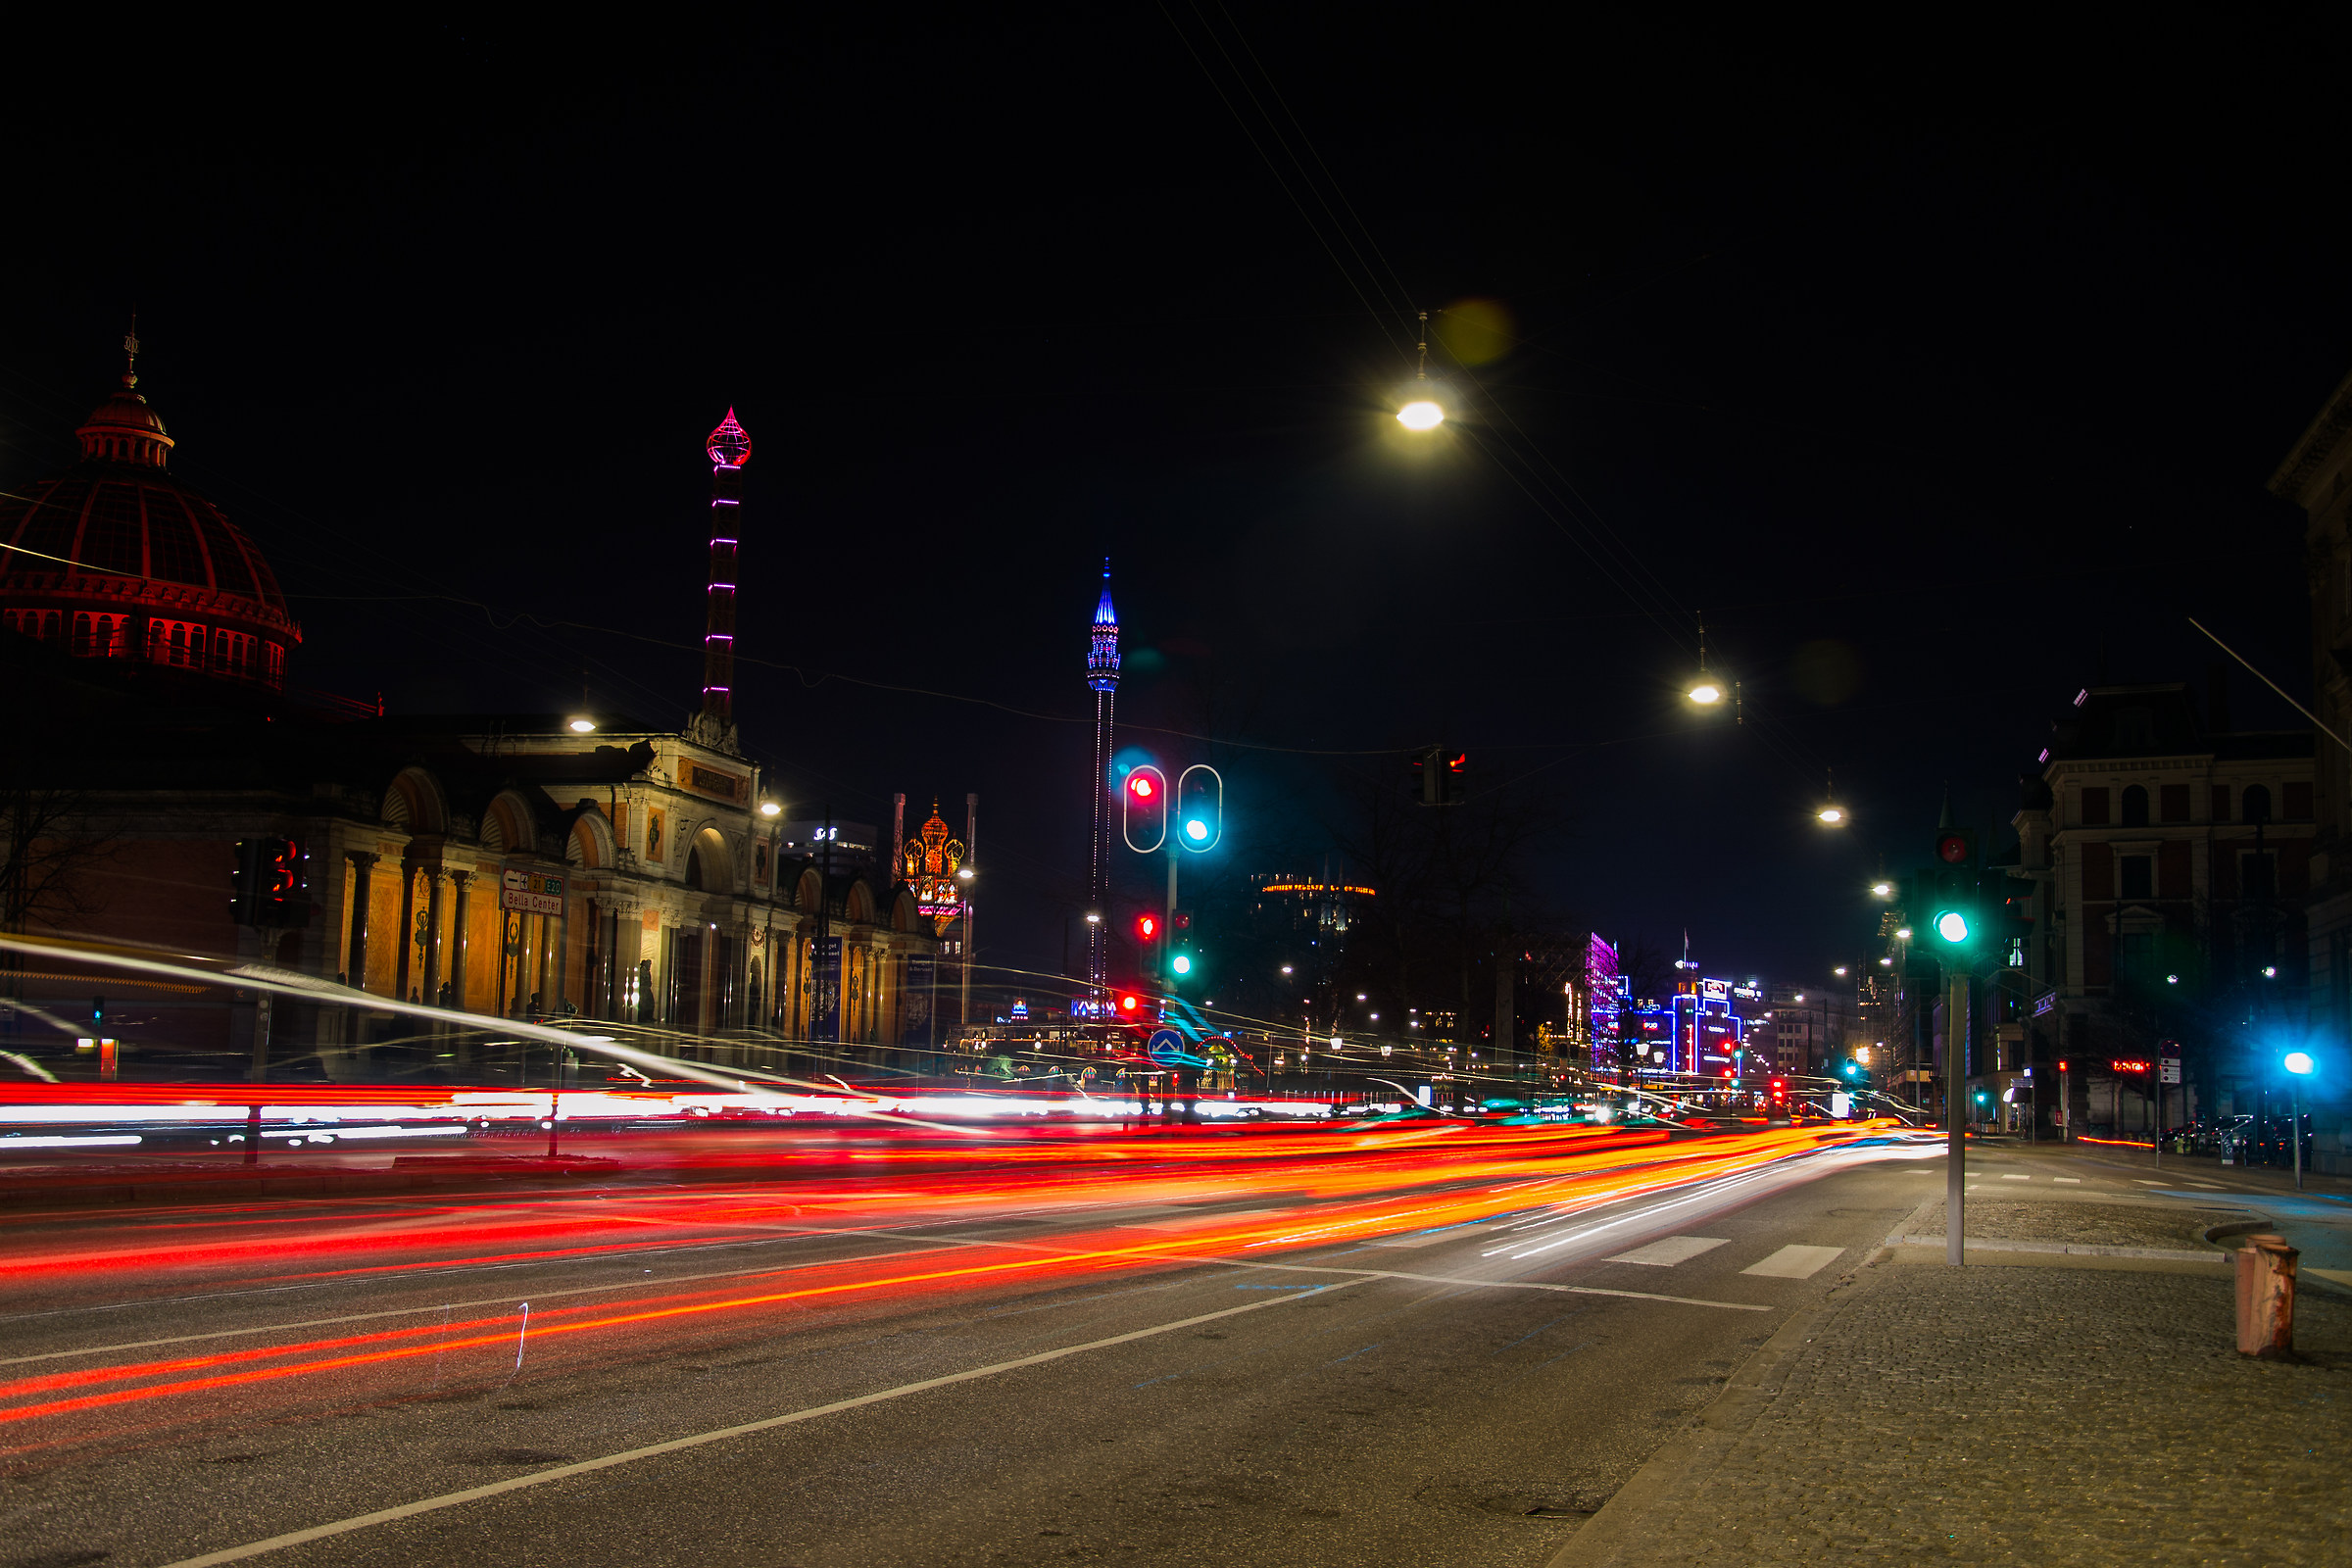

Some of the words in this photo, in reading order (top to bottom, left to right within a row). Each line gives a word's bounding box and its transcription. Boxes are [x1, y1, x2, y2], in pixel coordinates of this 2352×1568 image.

[534, 879, 541, 889] 21
[547, 881, 561, 893] E20
[509, 893, 528, 906] Bella
[532, 897, 559, 910] Center
